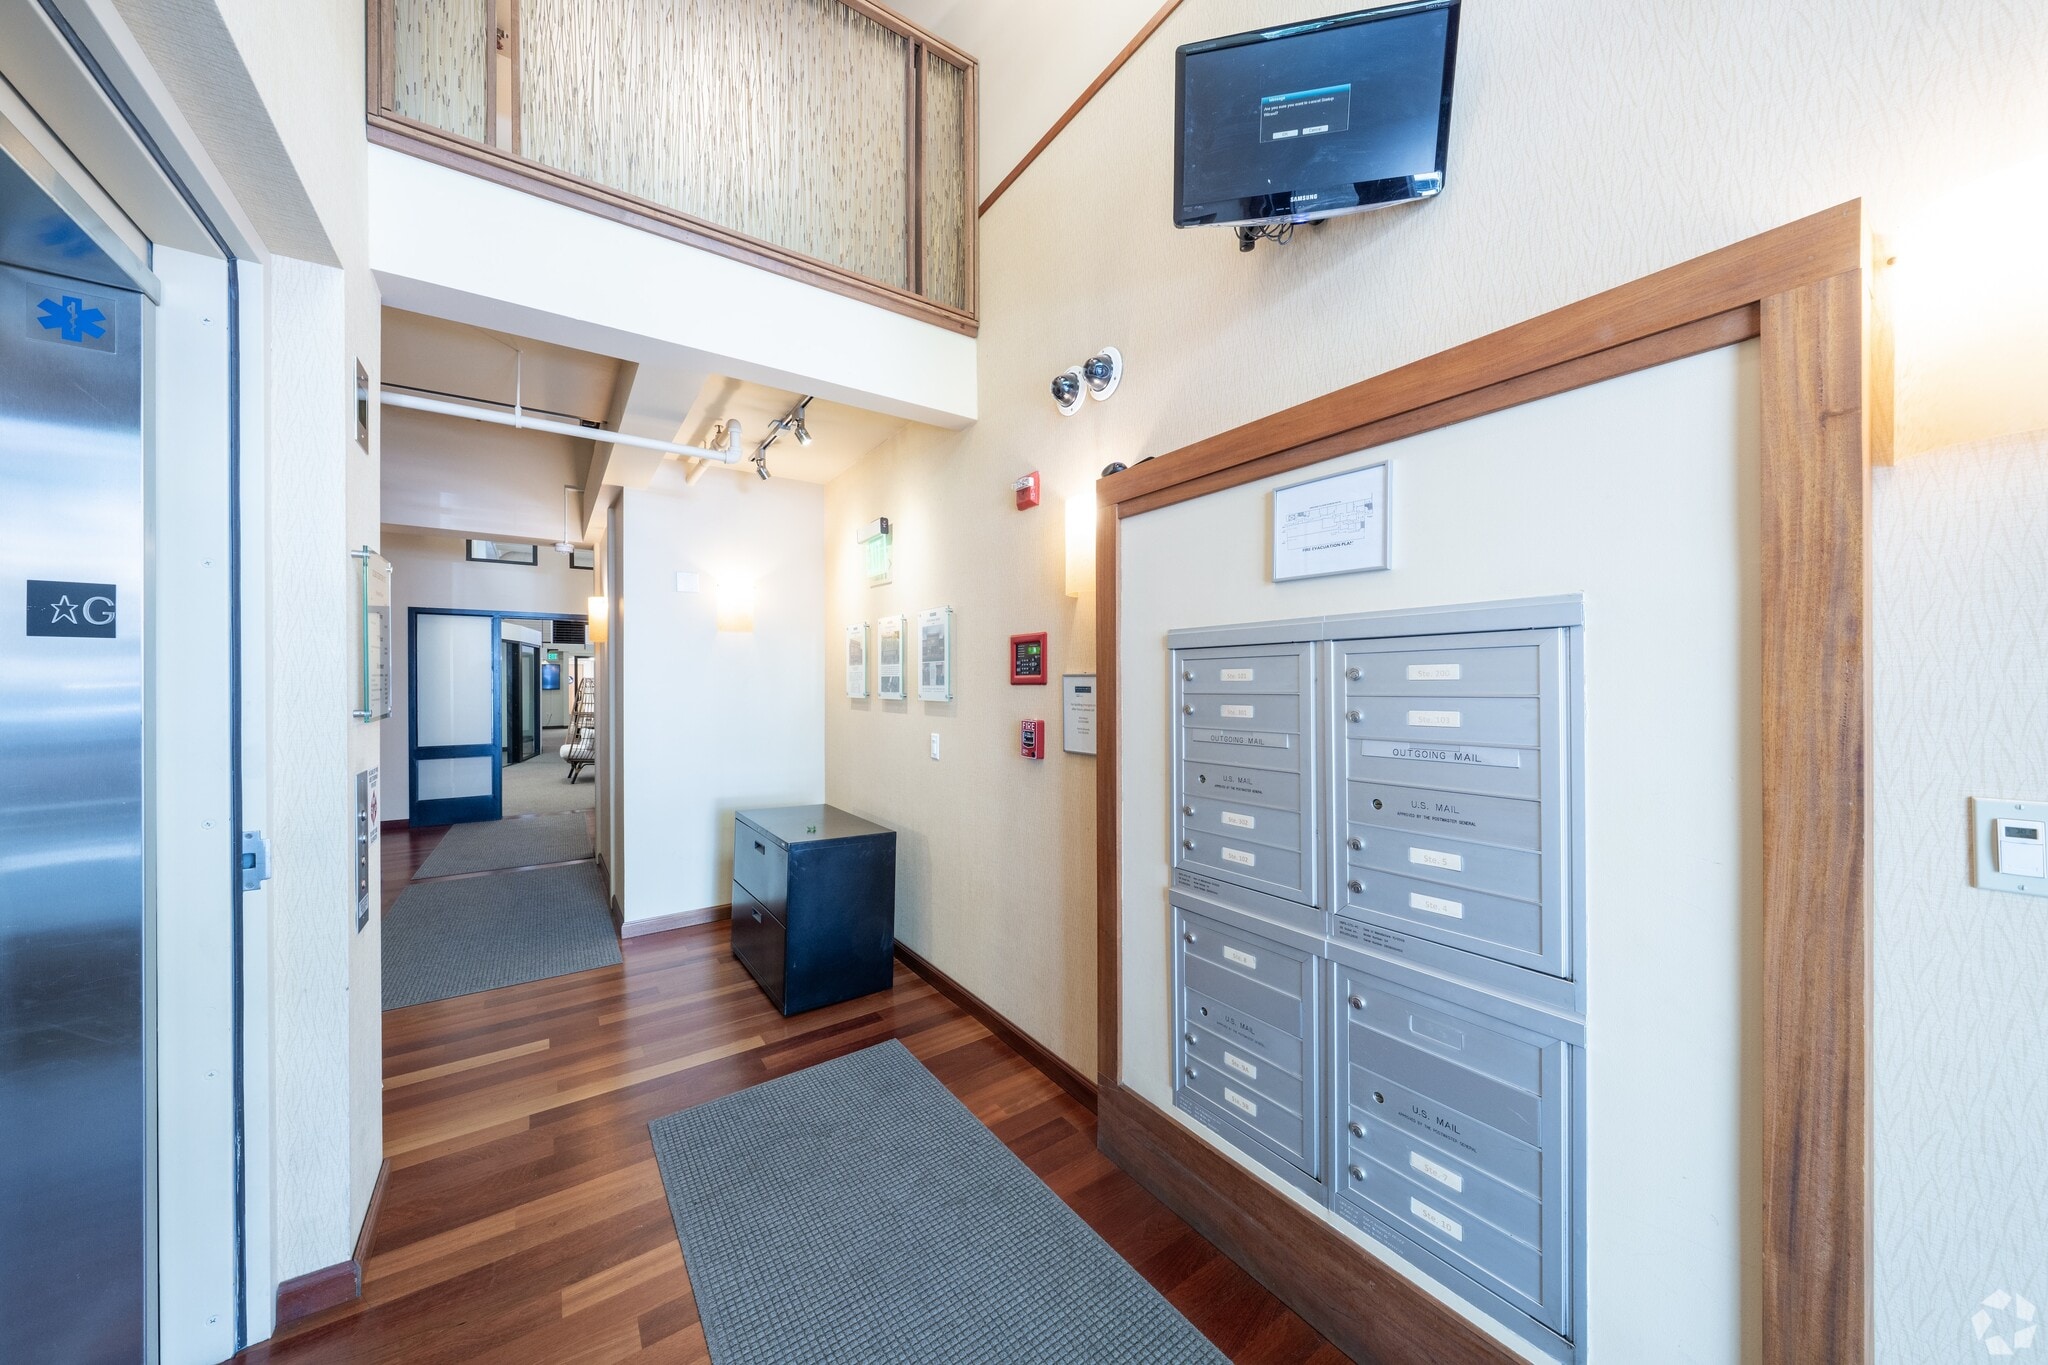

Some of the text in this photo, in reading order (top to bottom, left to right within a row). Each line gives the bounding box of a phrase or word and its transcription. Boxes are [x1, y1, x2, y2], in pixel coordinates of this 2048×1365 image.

[1290, 194, 1318, 202] SAMSUNG
[82, 596, 116, 625] G
[1022, 721, 1036, 731] FIRE
[1210, 734, 1244, 744] OUTGOING
[1392, 748, 1482, 763] OUTGOING MAIL
[1238, 777, 1253, 786] MAIL
[1411, 800, 1460, 814] U.S. MAIL
[1432, 816, 1457, 824] POSTMASTER
[1424, 855, 1440, 864] Ste.
[1425, 900, 1441, 911] Ste.
[1224, 1015, 1255, 1035] U.S. MAIL
[1412, 1104, 1461, 1135] U.S. MAIL
[1424, 1163, 1448, 1182] Ste. 7
[1423, 1204, 1452, 1231] Ste. 10
